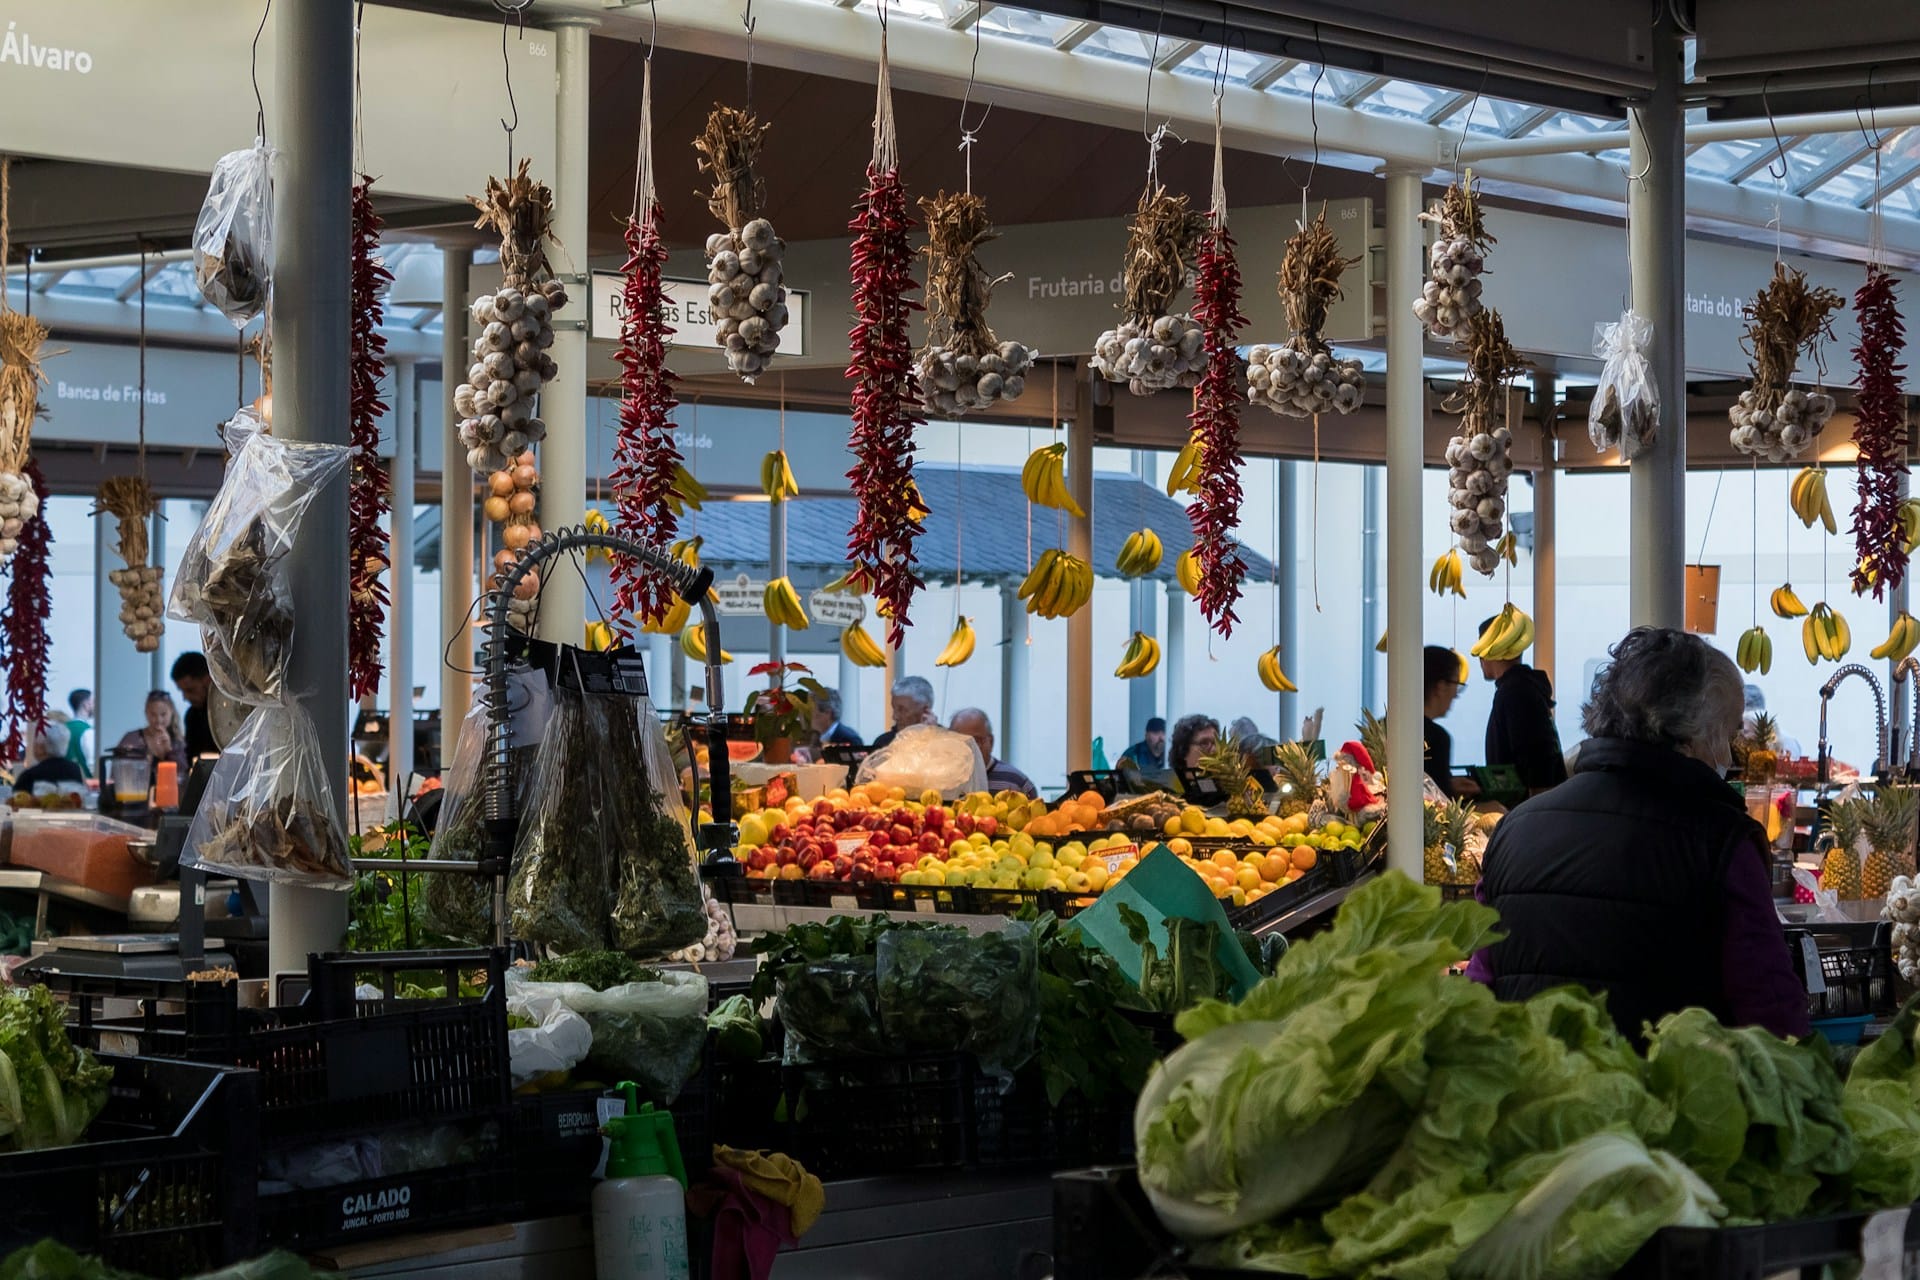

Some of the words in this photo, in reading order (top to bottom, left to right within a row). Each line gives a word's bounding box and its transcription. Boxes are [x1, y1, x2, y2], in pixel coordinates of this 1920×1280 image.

[0, 21, 93, 74] Álvaro
[529, 41, 548, 57] B66
[1028, 273, 1105, 299] Frutaria
[1109, 271, 1127, 293] d
[1686, 293, 1714, 315] taria
[1716, 296, 1732, 317] do
[57, 381, 100, 401] Banca
[102, 384, 121, 402] de
[342, 1185, 411, 1216] CALADO
[341, 1216, 368, 1232] JUNCAL
[373, 1212, 395, 1225] PORTO
